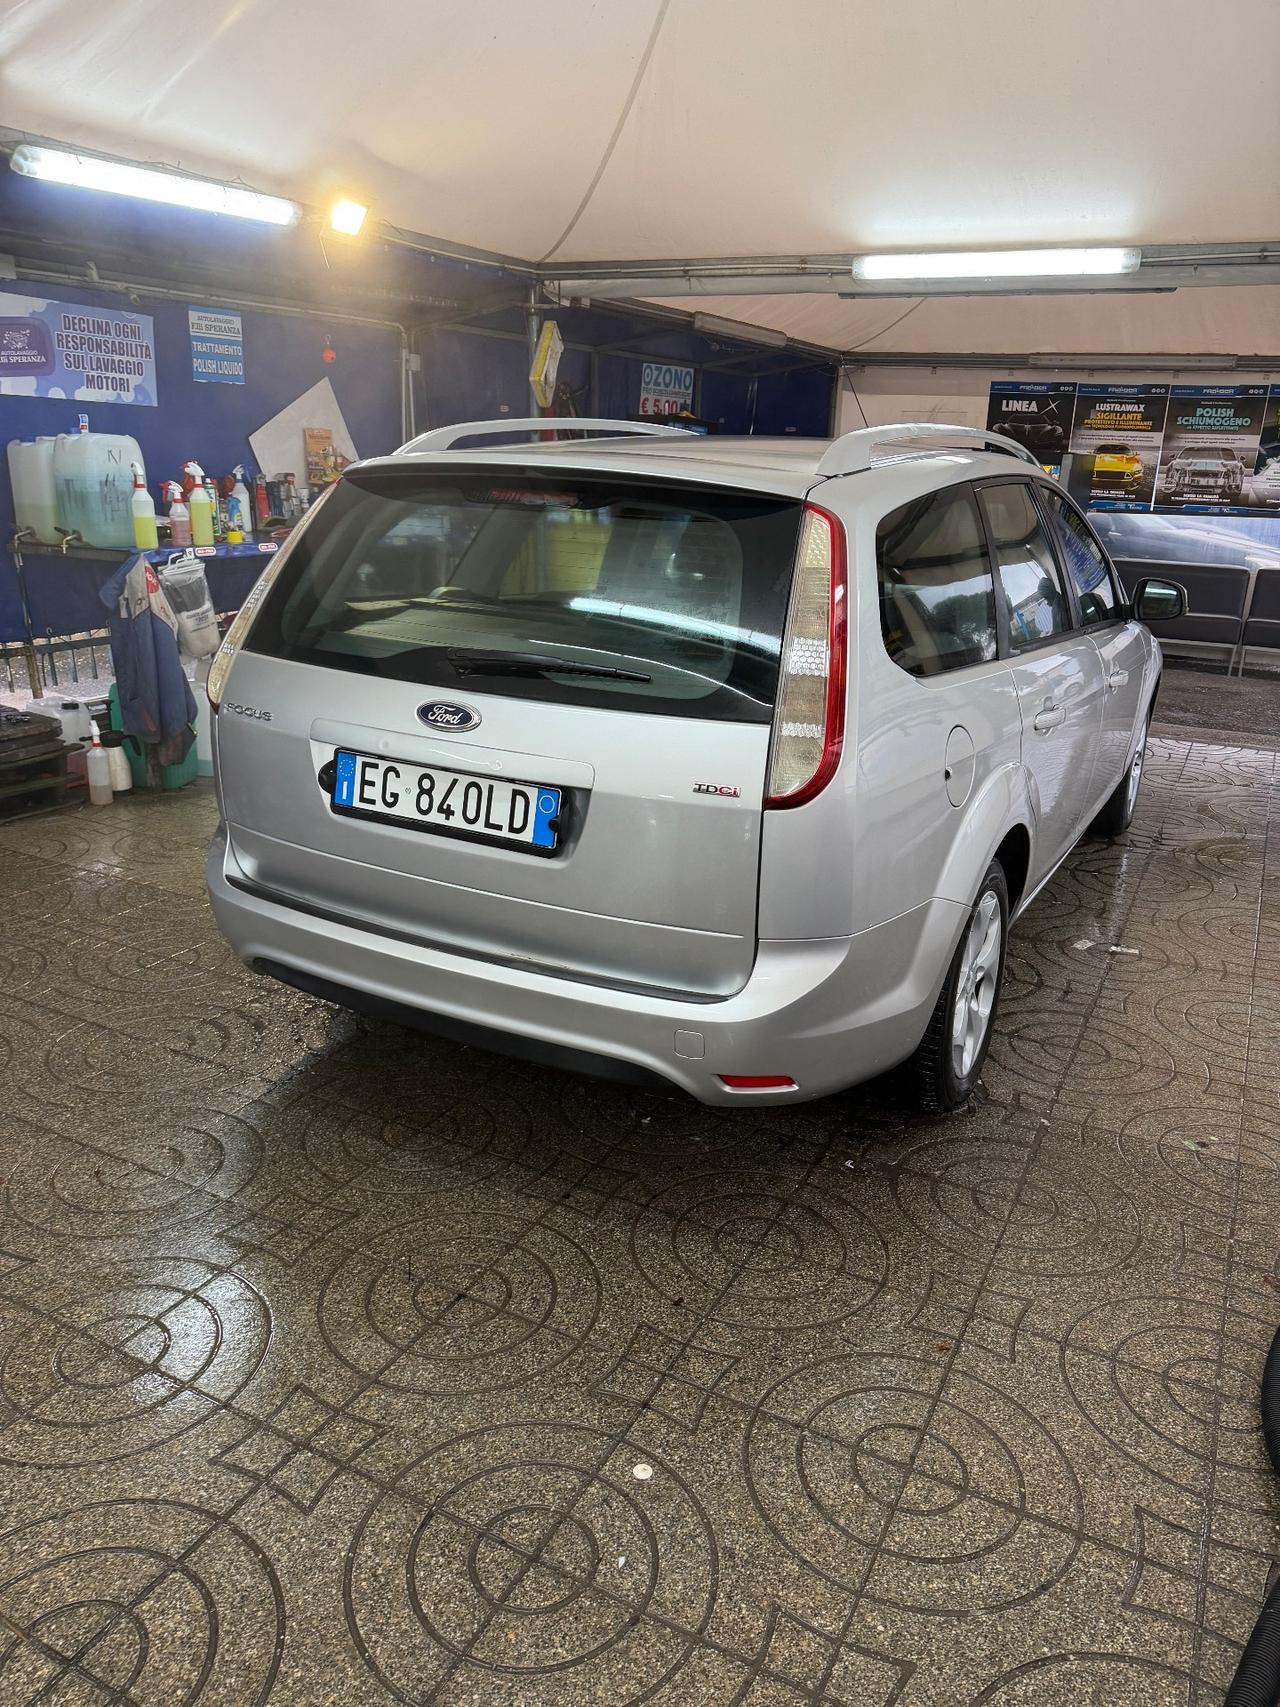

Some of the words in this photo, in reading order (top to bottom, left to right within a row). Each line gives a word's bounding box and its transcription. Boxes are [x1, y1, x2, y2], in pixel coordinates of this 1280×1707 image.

[63, 315, 112, 337] DECLINA
[114, 322, 142, 341] OGNI
[197, 315, 235, 325] AUTOLAVAGGIO
[205, 323, 241, 335] SPERANZA
[56, 332, 152, 360] RESPONSABILITÀ
[192, 341, 242, 356] TRATTAMENTO
[9, 355, 46, 363] SPERANZA
[65, 353, 88, 370] SUL
[90, 356, 144, 377] LAVAGGIO
[193, 358, 217, 373] POLISH
[218, 361, 243, 375] LIQUIDO
[86, 374, 130, 393] MOTORI
[643, 365, 692, 391] OZONO
[641, 397, 649, 415] €
[1002, 400, 1038, 412] LINEA
[1039, 398, 1062, 415] X
[1096, 403, 1146, 412] LUSTRAWAX
[1196, 408, 1234, 417] POLISH
[1096, 412, 1142, 420] SIGILLANTE
[1176, 416, 1251, 426] SCHIUMOGENO
[224, 702, 273, 722] FOCUS
[428, 704, 464, 724] Ford
[358, 760, 401, 808] EG
[415, 772, 531, 835] 840LD
[694, 783, 738, 796] TDCi
